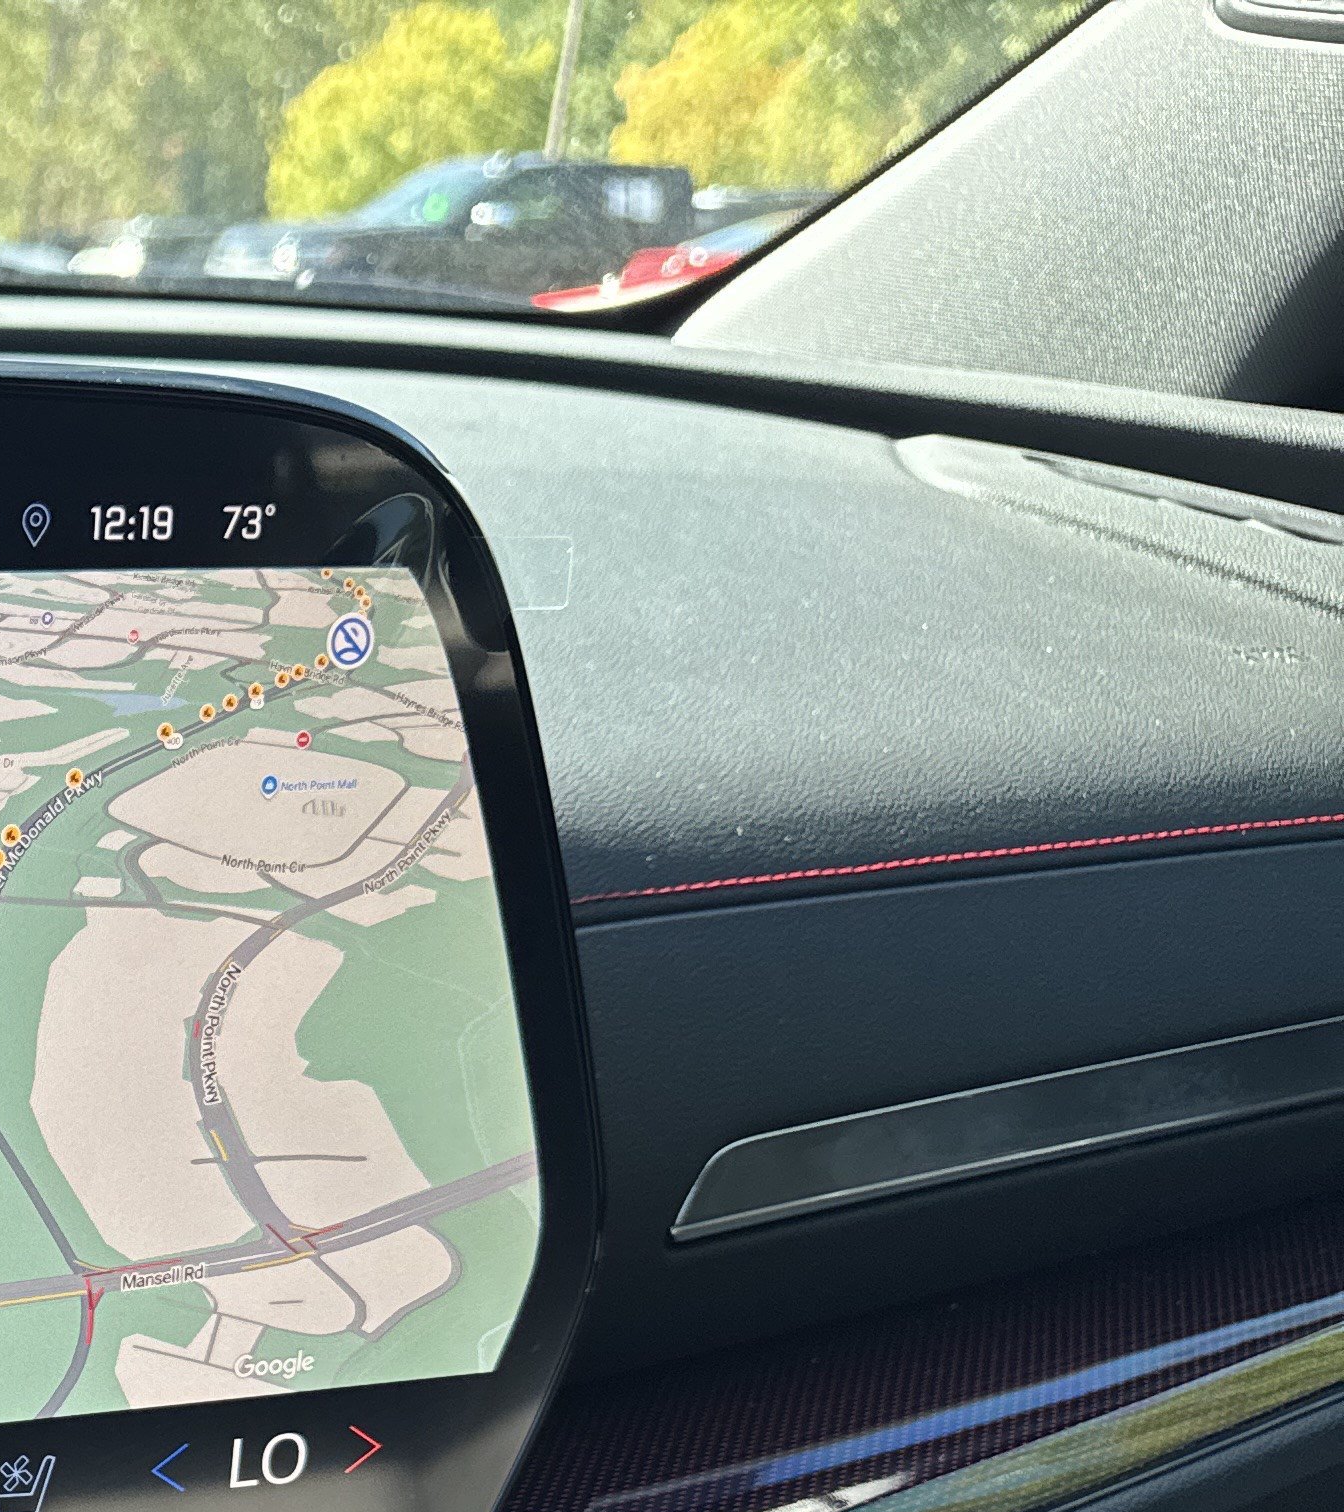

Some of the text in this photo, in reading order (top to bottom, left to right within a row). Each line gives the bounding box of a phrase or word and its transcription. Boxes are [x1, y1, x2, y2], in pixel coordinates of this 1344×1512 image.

[90, 506, 174, 541] 12:19
[222, 504, 276, 540] 73°
[395, 692, 427, 715] Haynes
[428, 708, 454, 729] Bridge
[3, 757, 15, 768] Dr
[172, 748, 199, 768] North
[200, 740, 226, 755] Point
[281, 778, 358, 791] North Point Mall
[4, 797, 65, 871] McDonald
[64, 769, 104, 804] Pkwy
[221, 854, 254, 871] North
[256, 859, 287, 874] Point
[364, 810, 452, 895] North Point Pkwy
[202, 963, 242, 1103] North Point Pkwy
[121, 1265, 204, 1290] Mansell Rd
[234, 1350, 315, 1381] Google
[228, 1431, 310, 1490] LO
